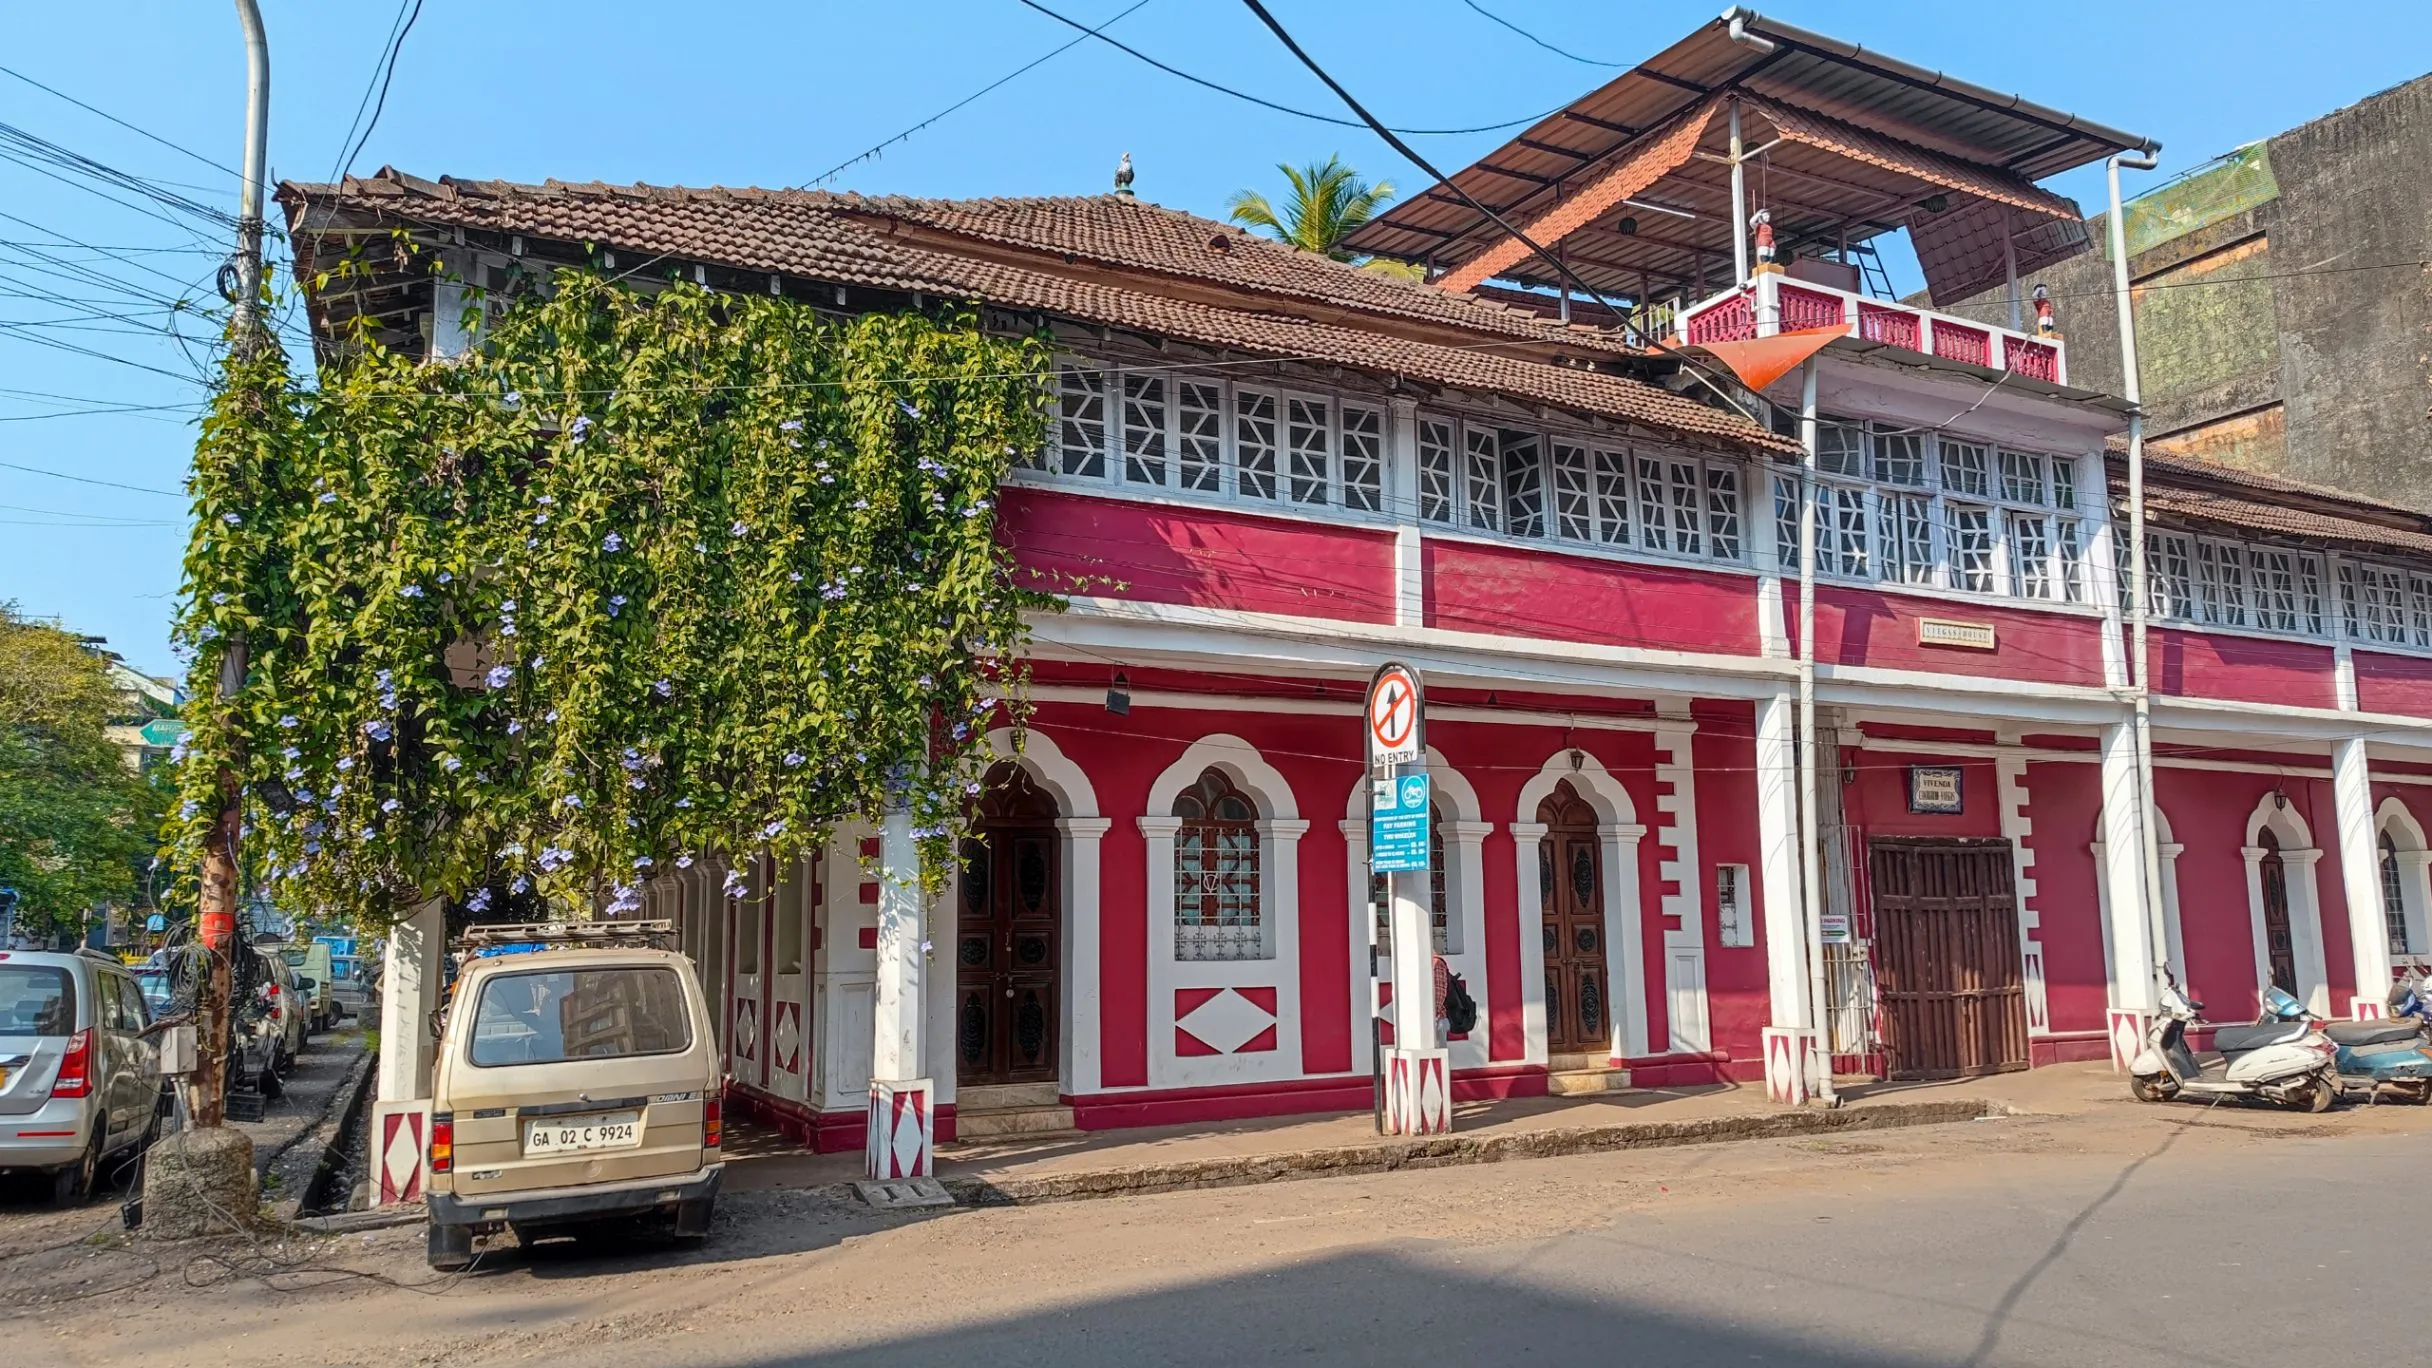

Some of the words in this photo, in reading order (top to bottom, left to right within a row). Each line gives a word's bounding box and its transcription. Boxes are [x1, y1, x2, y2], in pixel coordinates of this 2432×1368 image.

[1926, 626, 1957, 636] VIEGAS
[1962, 630, 1987, 640] HOUSE
[1375, 755, 1385, 765] NO
[1388, 750, 1414, 763] ENTRY
[656, 1093, 686, 1102] OMNI
[533, 1132, 549, 1146] GA
[560, 1130, 576, 1144] 02
[583, 1128, 592, 1142] C
[600, 1125, 632, 1140] 9924
